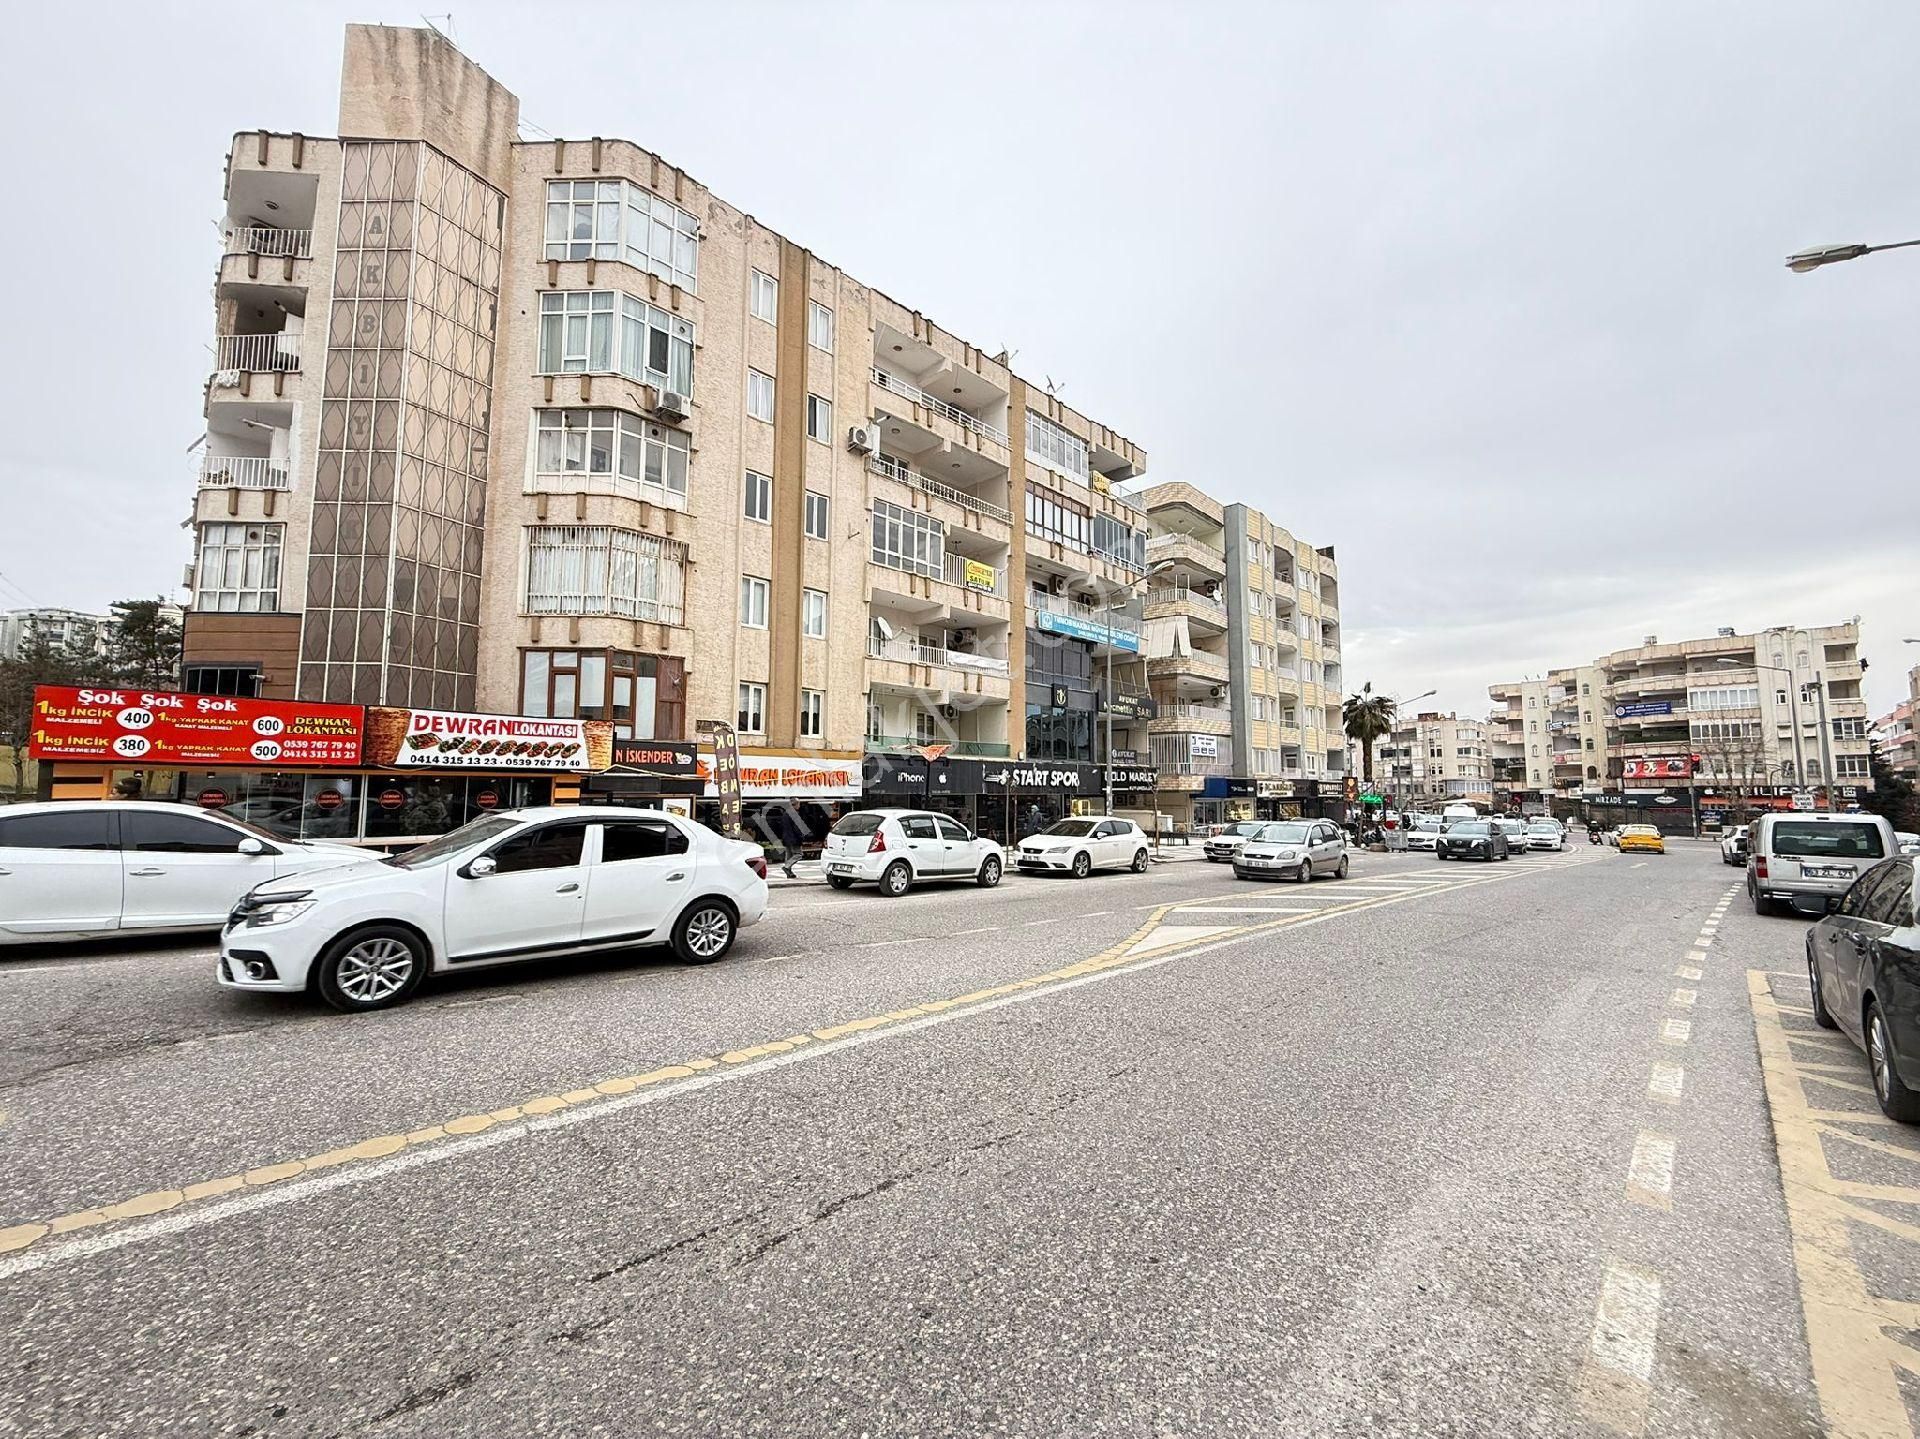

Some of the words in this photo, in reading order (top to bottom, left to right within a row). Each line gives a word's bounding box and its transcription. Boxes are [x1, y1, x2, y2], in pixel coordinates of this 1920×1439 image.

[77, 689, 127, 706] Şok
[140, 693, 185, 709] Şok
[197, 698, 238, 713] Şok
[36, 700, 67, 717] 1kg
[71, 706, 113, 718] İNCİK
[124, 712, 150, 724] 400
[218, 718, 249, 726] KANAT
[295, 716, 351, 726] DEWRAN
[257, 719, 279, 731] 600
[286, 725, 357, 735] LOKANTASI
[414, 714, 513, 736] DEWRAN
[514, 721, 577, 737] LOKANTASI
[32, 729, 63, 746] 1kg
[67, 735, 110, 746] İNCİK
[119, 738, 145, 750] 380
[283, 740, 308, 749] 0539
[311, 740, 329, 749] 767
[331, 741, 343, 749] 79
[345, 741, 357, 749] 40
[255, 745, 278, 756] 500
[282, 749, 308, 758] 0414
[309, 750, 328, 759] 315
[344, 751, 356, 759] 23
[626, 747, 674, 764] İSKENDER
[410, 754, 440, 764] 0414
[442, 756, 464, 765] 315
[468, 757, 481, 765] 13
[484, 758, 497, 766] 23
[505, 758, 531, 766] 0539
[534, 759, 551, 767] 767
[554, 759, 566, 767] 79
[897, 771, 925, 783] iPhone
[1012, 768, 1049, 787] START
[1050, 770, 1080, 787] SPOR
[1129, 771, 1158, 782] MARLEY
